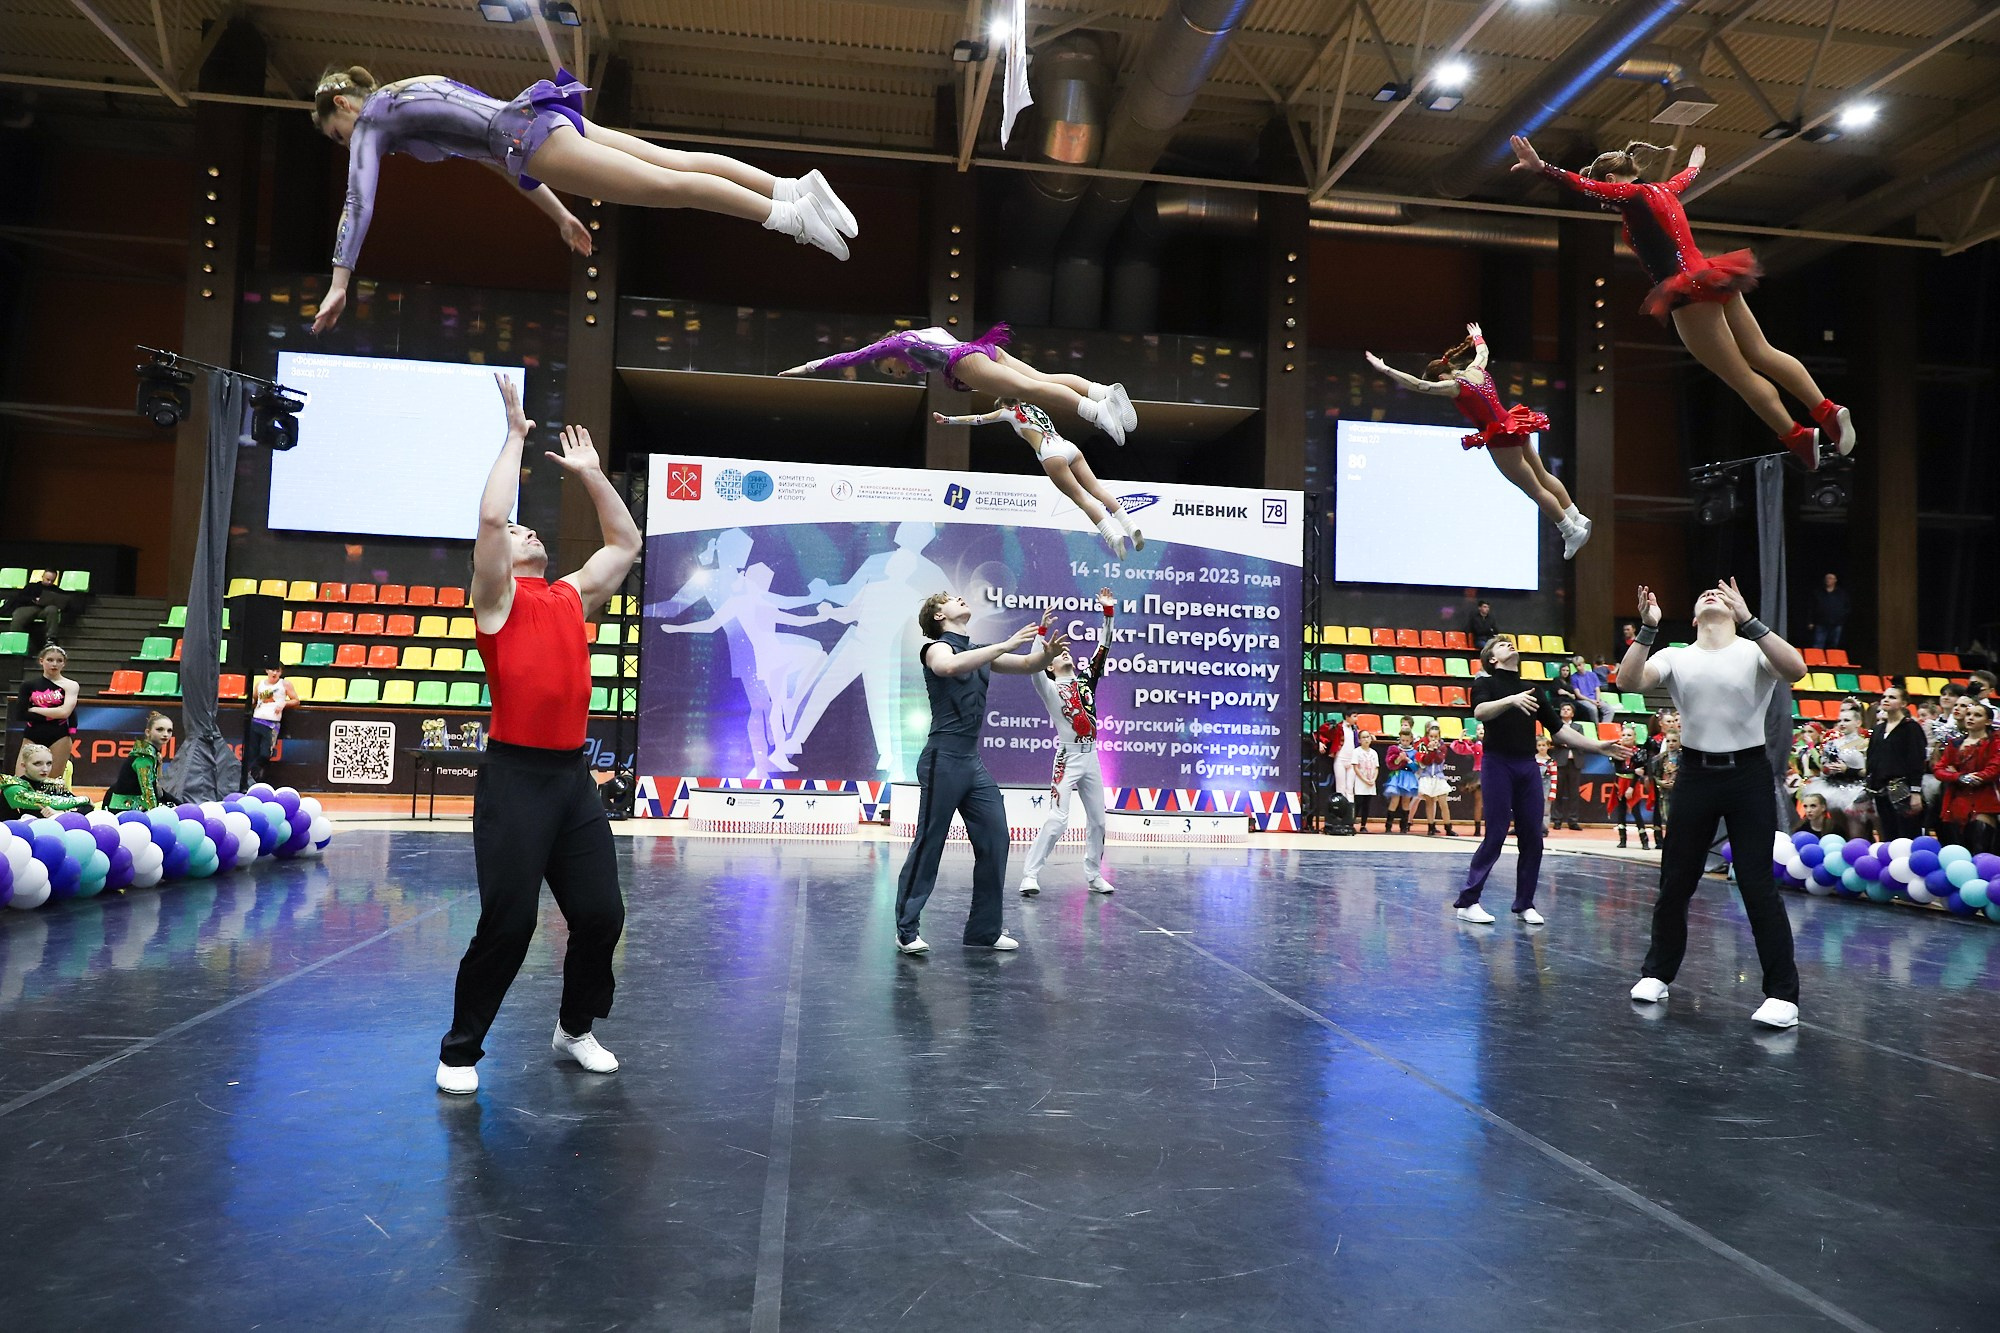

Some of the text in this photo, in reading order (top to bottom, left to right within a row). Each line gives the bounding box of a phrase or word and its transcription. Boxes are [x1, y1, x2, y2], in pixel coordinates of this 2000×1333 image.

[317, 368, 331, 380] 2/2
[778, 481, 817, 489] ФИЗИЧЕСКОЙ
[975, 490, 1037, 498] САНКТ-ПЕТЕРБУРГСКАЯ
[975, 496, 1037, 508] ФЕДЕРАЦИЯ
[1172, 503, 1248, 519] ДНЕВНИК
[1266, 504, 1283, 518] 78
[1070, 561, 1090, 577] 14
[1103, 563, 1121, 578] 15
[1124, 566, 1195, 584] октября
[1199, 567, 1240, 584] 2023
[1243, 573, 1281, 587] года
[986, 587, 1280, 620] Чемпиона и Первенство
[1077, 654, 1280, 682] аробатическому
[1135, 687, 1280, 712] рок-н-роллу
[986, 711, 1281, 738] Санкт-бургский фестиваль
[983, 736, 1280, 761] по акробескому рок-н-роллу
[1180, 759, 1280, 778] и буги-вуги
[771, 798, 785, 819] 2
[1182, 818, 1192, 833] 3
